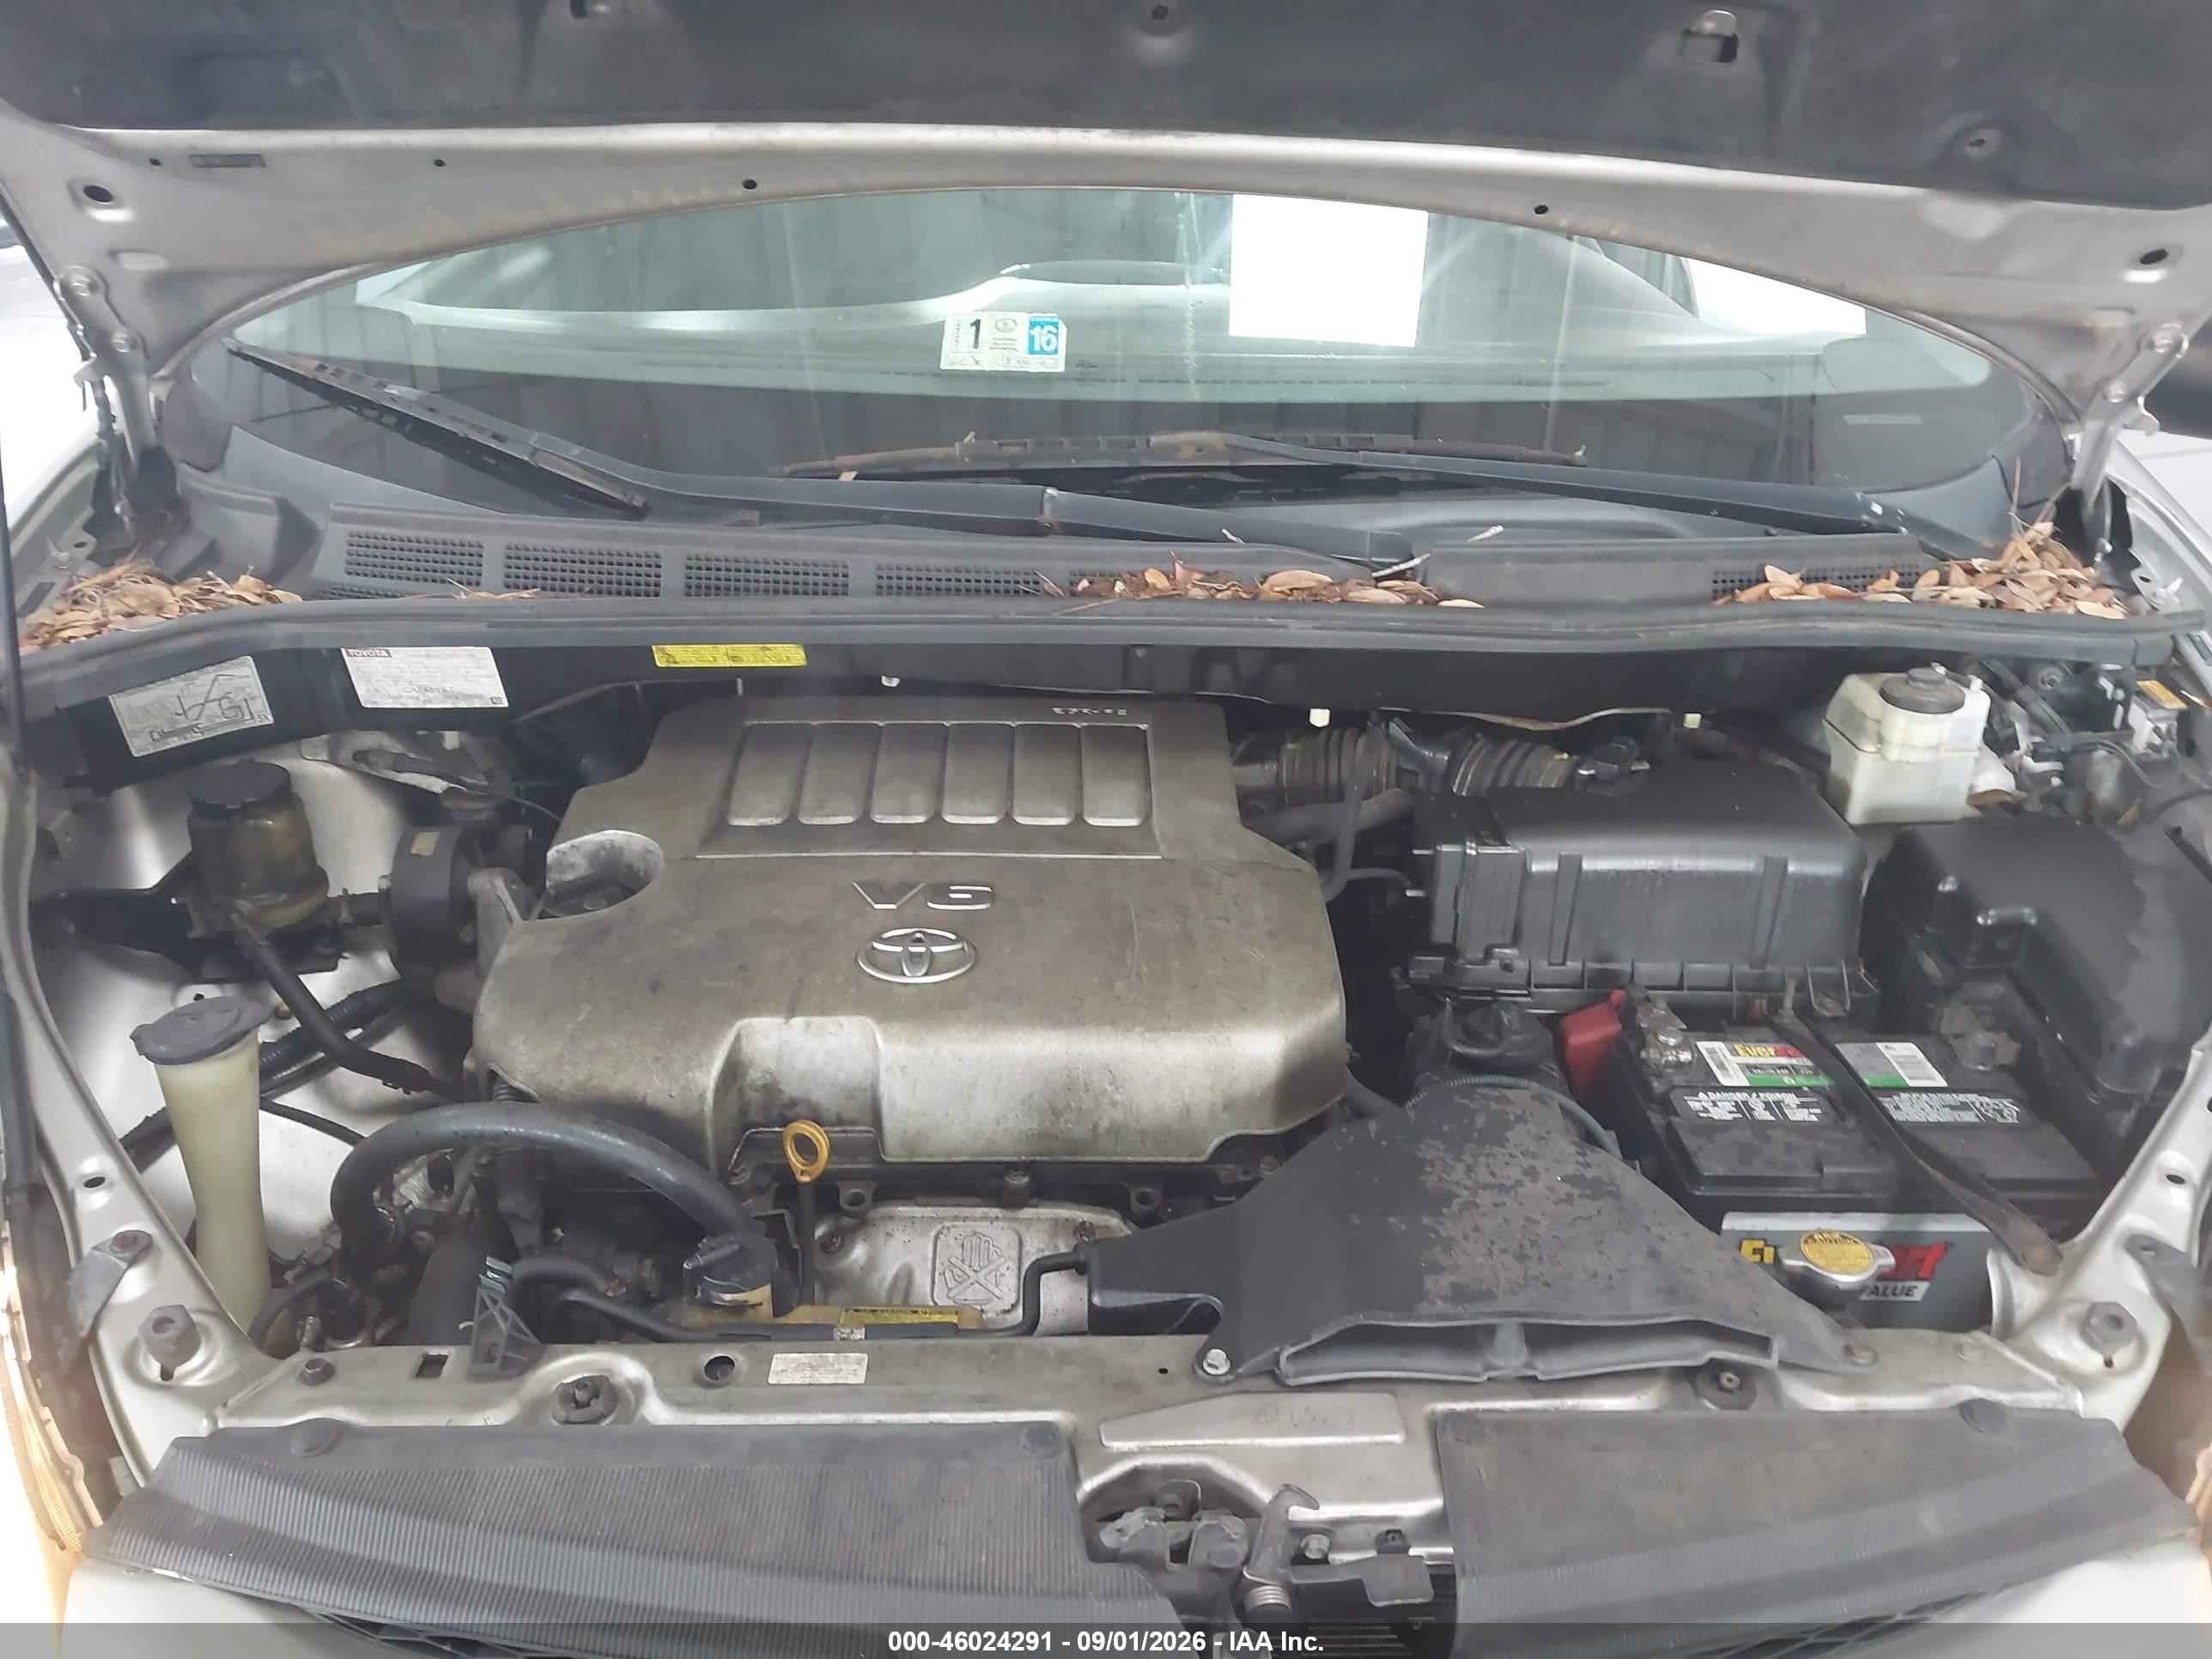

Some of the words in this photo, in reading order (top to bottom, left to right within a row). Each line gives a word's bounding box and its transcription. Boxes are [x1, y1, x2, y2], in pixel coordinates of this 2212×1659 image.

[970, 319, 981, 349] 1
[1030, 325, 1058, 352] 16
[347, 649, 389, 658] TOYOTA
[852, 882, 994, 911] V6
